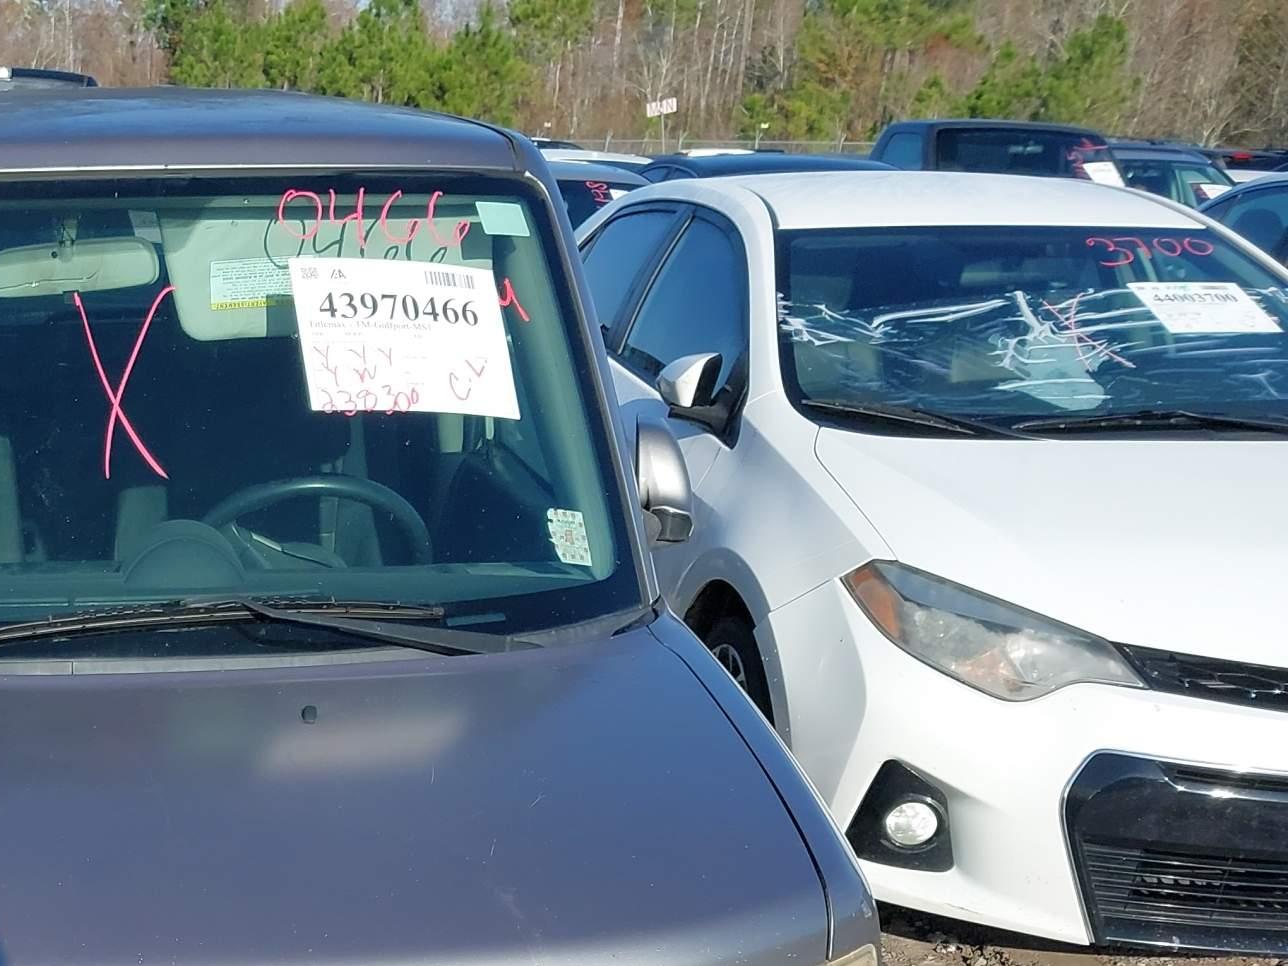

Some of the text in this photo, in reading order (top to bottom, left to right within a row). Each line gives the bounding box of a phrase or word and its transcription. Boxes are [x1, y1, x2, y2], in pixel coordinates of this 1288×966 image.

[278, 187, 470, 249] 0466
[1085, 236, 1214, 267] 3700
[319, 291, 479, 328] 43970466
